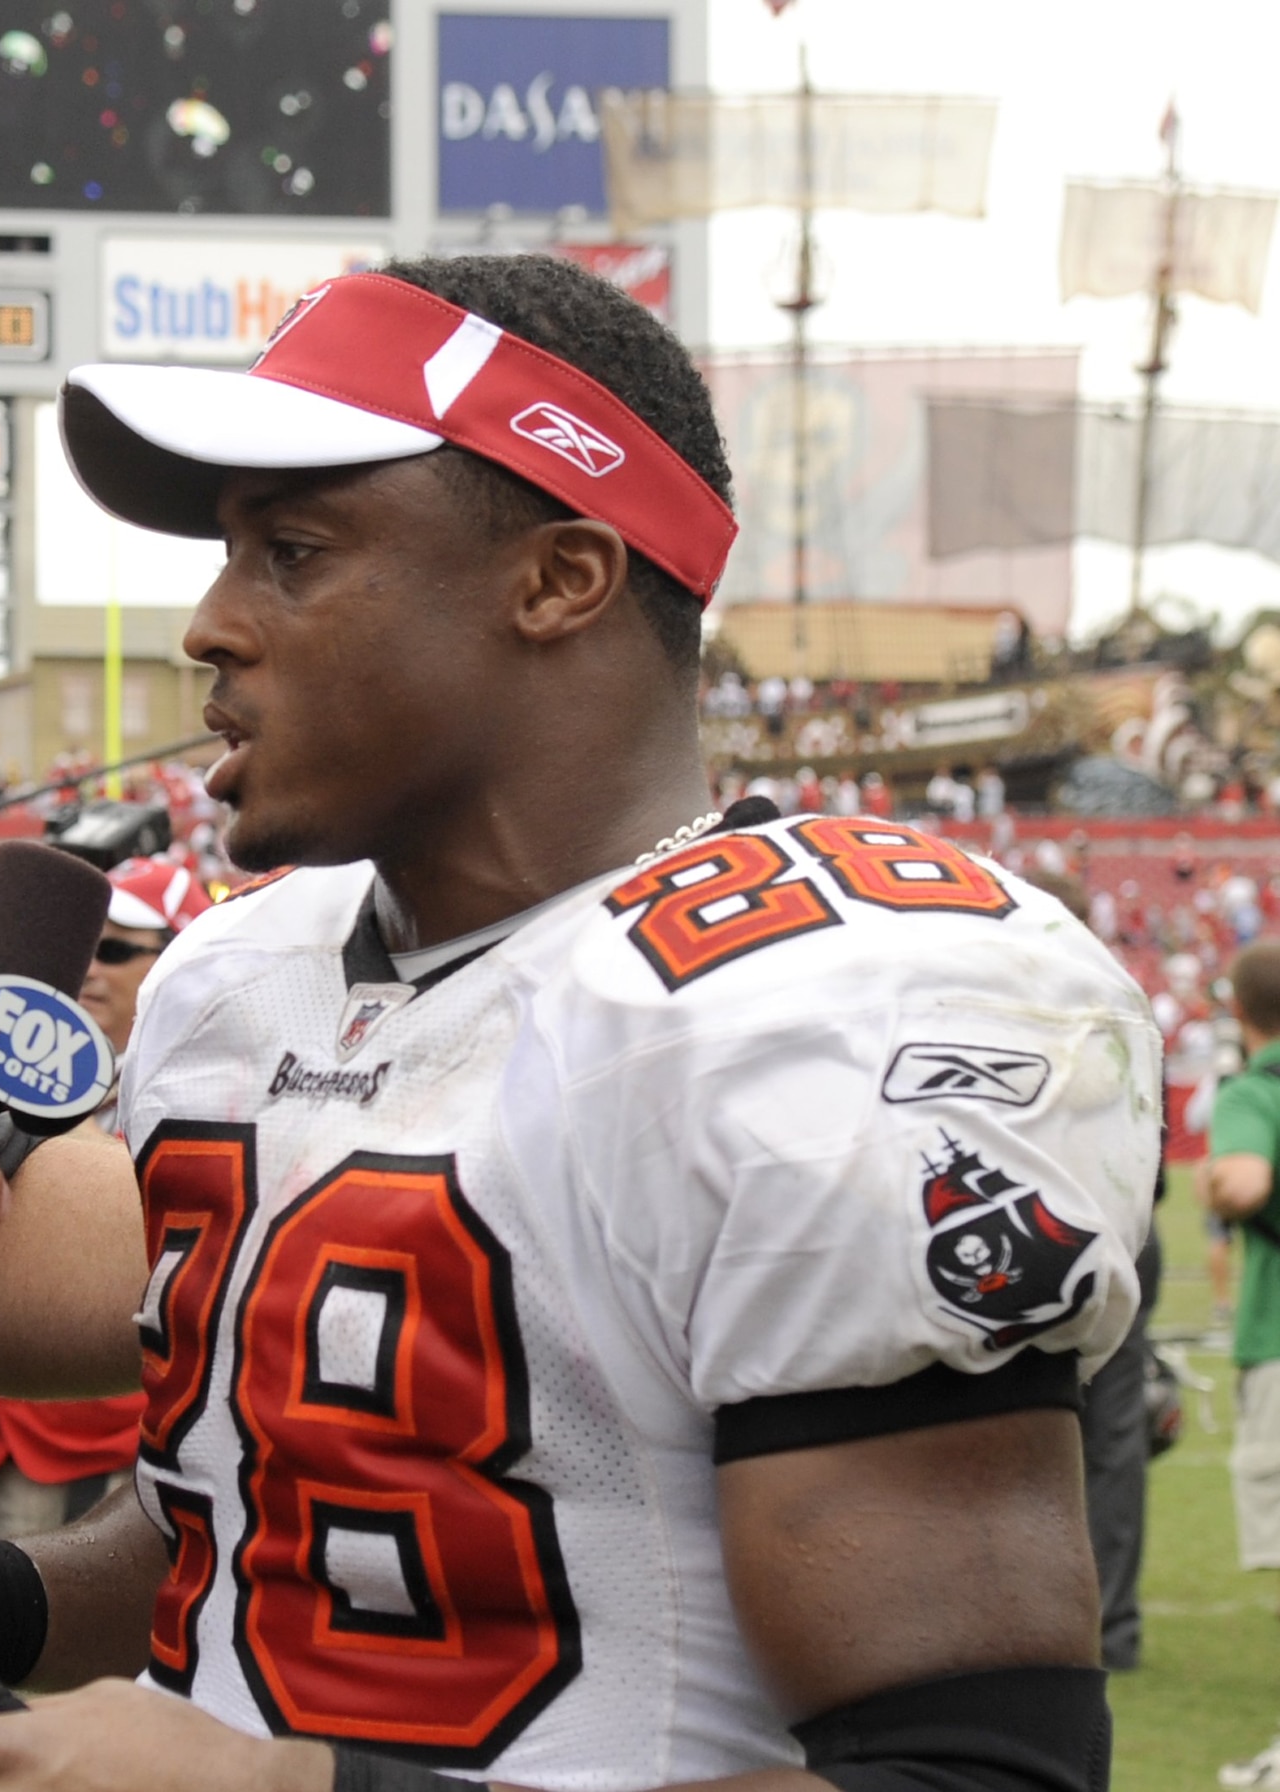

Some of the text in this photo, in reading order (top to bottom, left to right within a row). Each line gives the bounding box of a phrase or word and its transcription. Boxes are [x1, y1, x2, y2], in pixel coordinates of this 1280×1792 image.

[115, 273, 323, 342] StubH
[602, 815, 1019, 993] 28
[133, 1118, 582, 1769] 28
